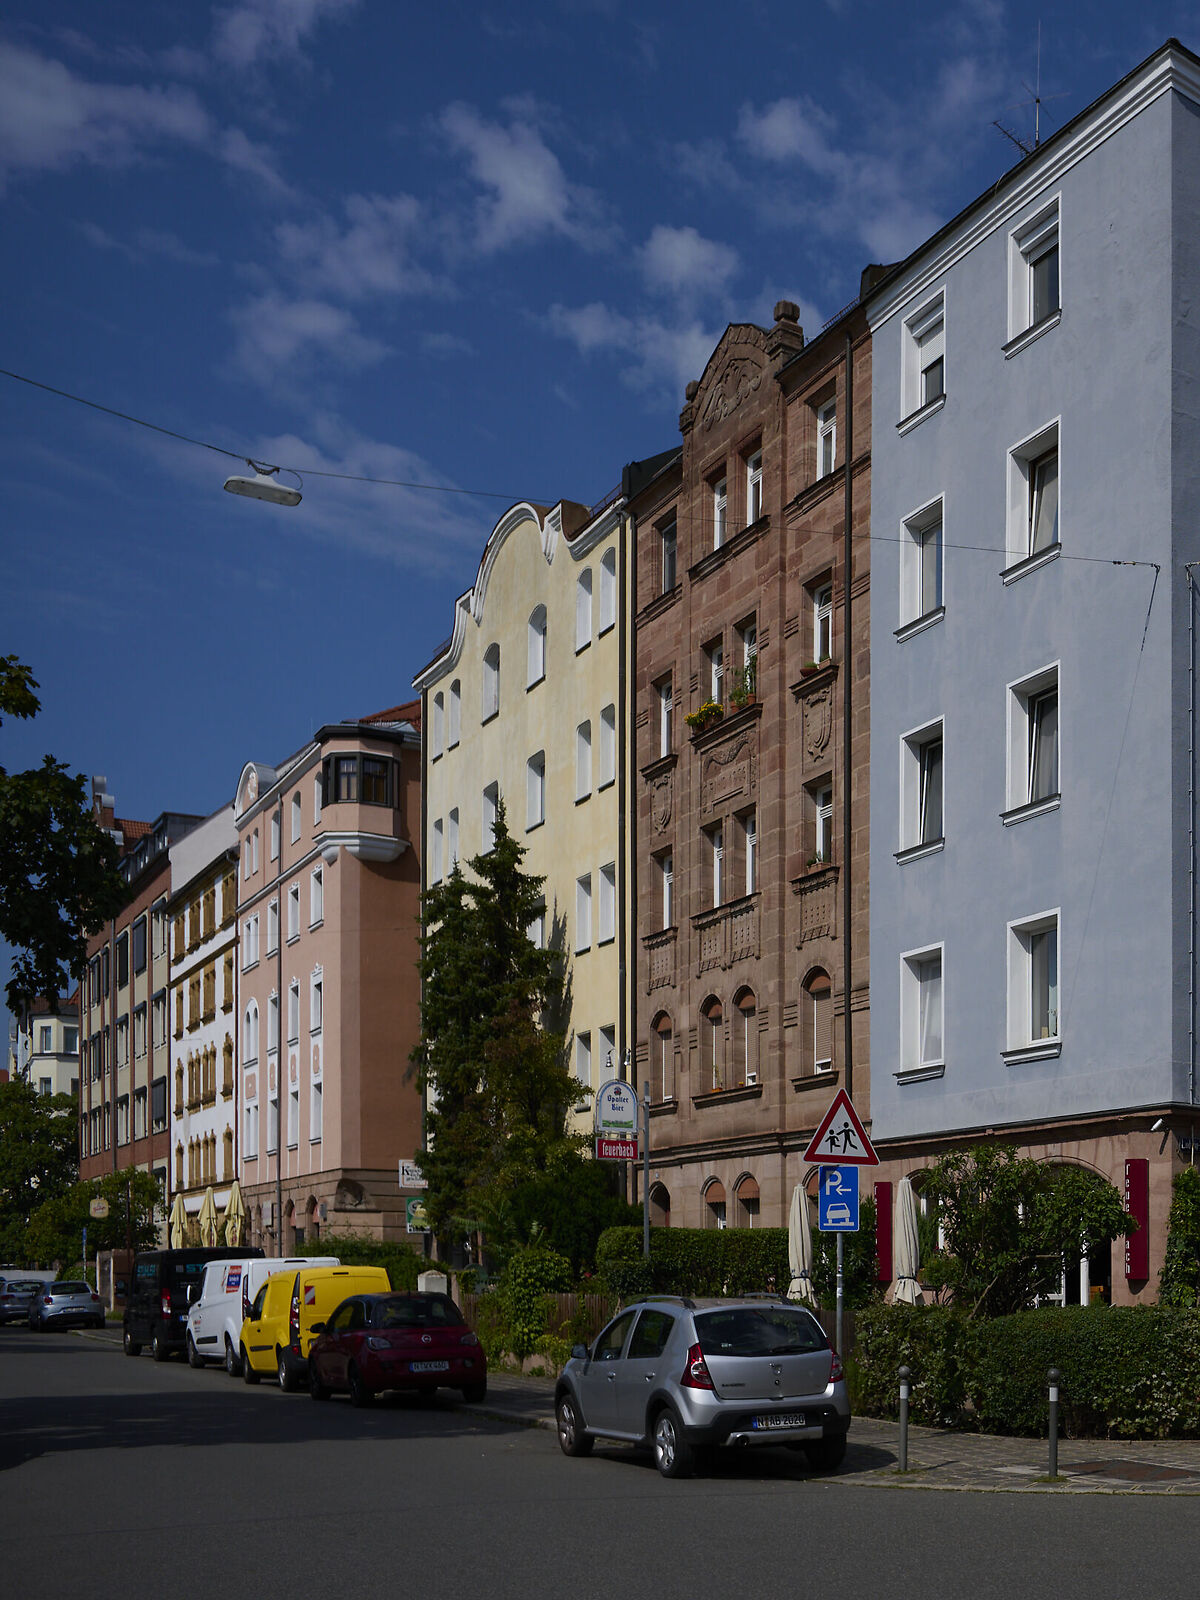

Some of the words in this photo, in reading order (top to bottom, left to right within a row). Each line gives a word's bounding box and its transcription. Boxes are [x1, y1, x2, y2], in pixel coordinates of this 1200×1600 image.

[602, 1142, 634, 1157] feuerbach
[825, 1170, 842, 1196] P
[783, 1415, 805, 1425] 2020
